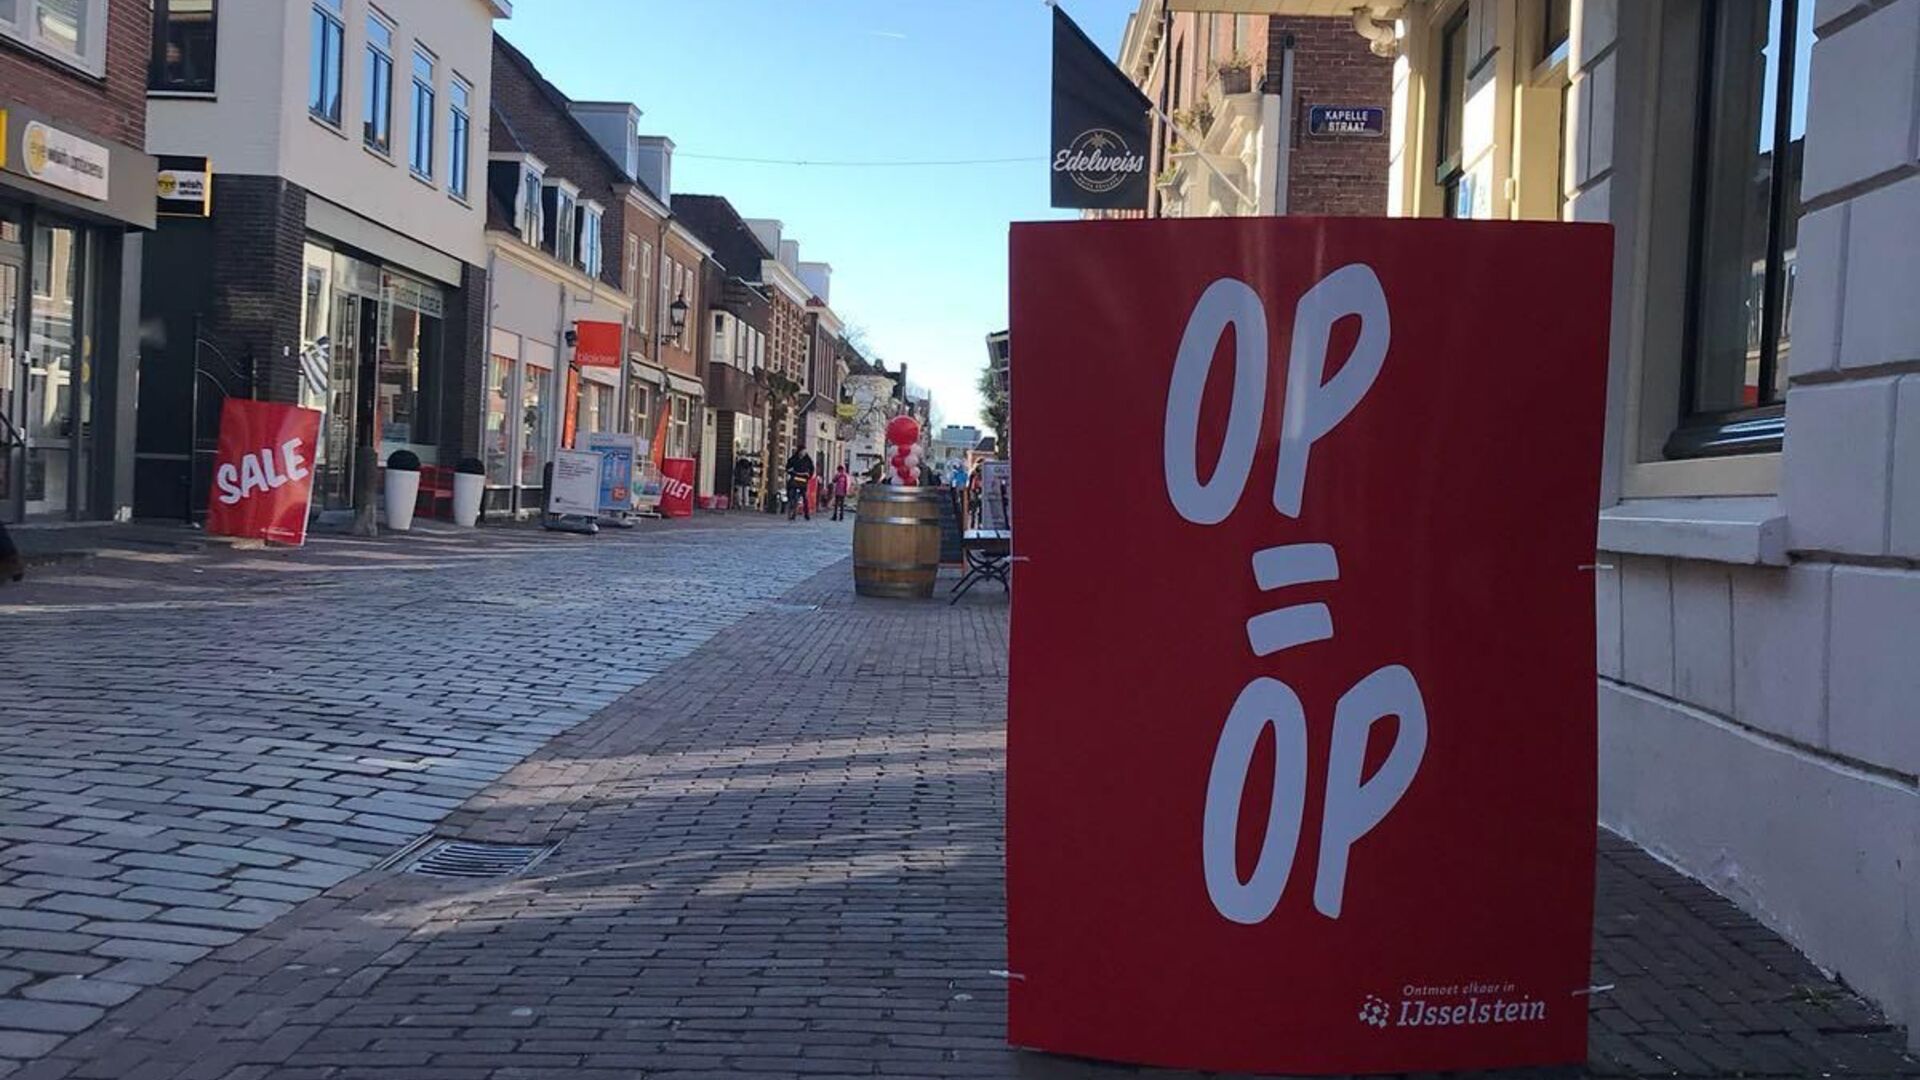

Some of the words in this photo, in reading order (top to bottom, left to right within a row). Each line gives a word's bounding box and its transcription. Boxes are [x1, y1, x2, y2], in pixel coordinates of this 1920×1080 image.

[1324, 110, 1368, 121] KAPELLE
[1328, 121, 1366, 132] STRAAT
[1052, 148, 1145, 173] Edelweiss
[1163, 263, 1391, 525] OP
[216, 437, 310, 505] SALE
[1202, 664, 1429, 925] OP
[1403, 984, 1459, 996] Ontmoet
[1462, 982, 1500, 995] elkaar
[1503, 981, 1516, 993] in
[1396, 994, 1546, 1027] IJsselstein
